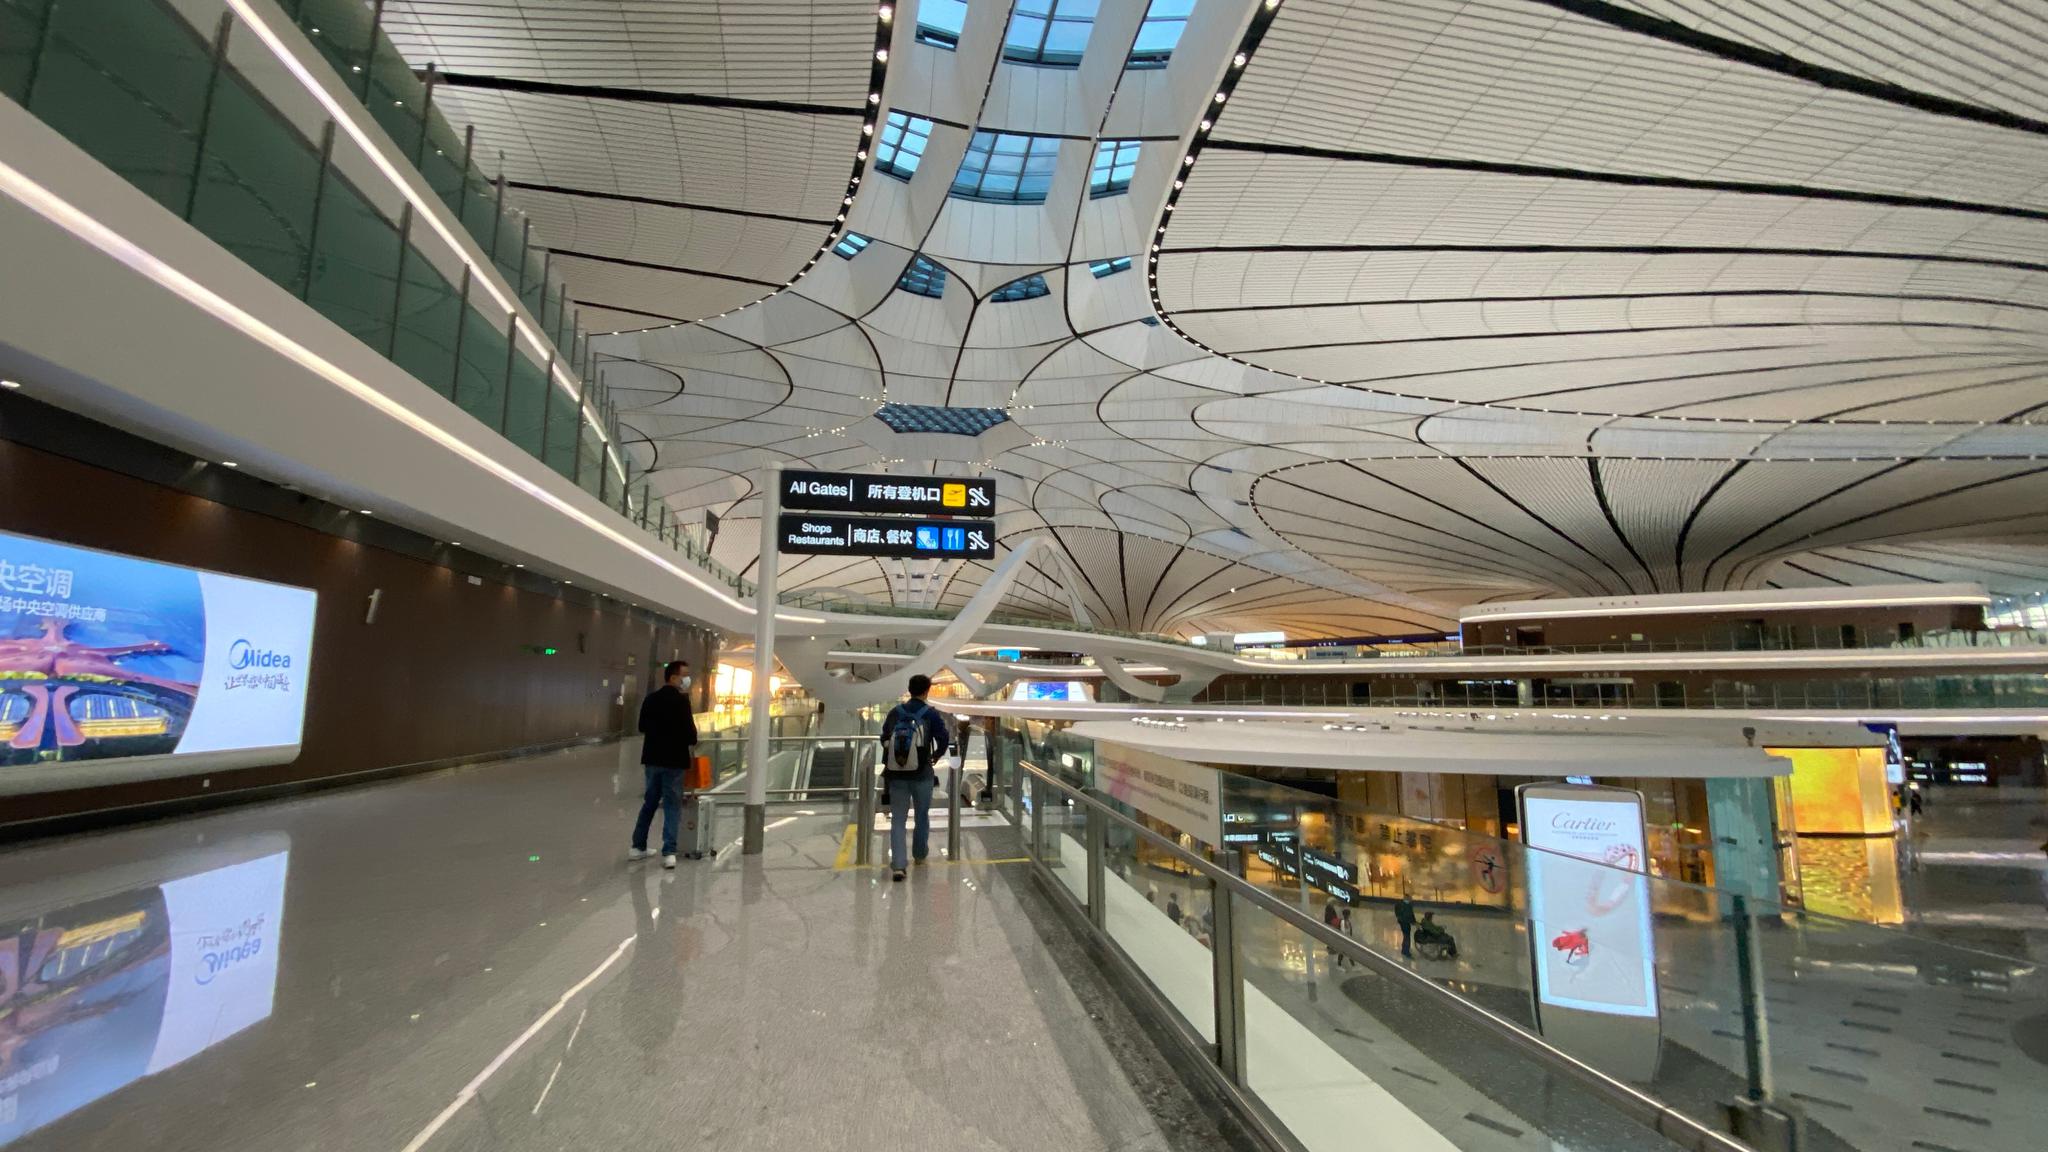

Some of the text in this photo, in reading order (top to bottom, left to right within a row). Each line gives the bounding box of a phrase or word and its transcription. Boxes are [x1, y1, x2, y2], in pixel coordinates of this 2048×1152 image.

[789, 480, 848, 496] All Gates
[867, 484, 941, 501] 所有登机口
[801, 523, 832, 534] Shops
[853, 528, 913, 544] 商店、餐饮
[788, 534, 845, 546] Restaurants
[229, 638, 291, 670] Midea
[1552, 811, 1616, 831] Cartier
